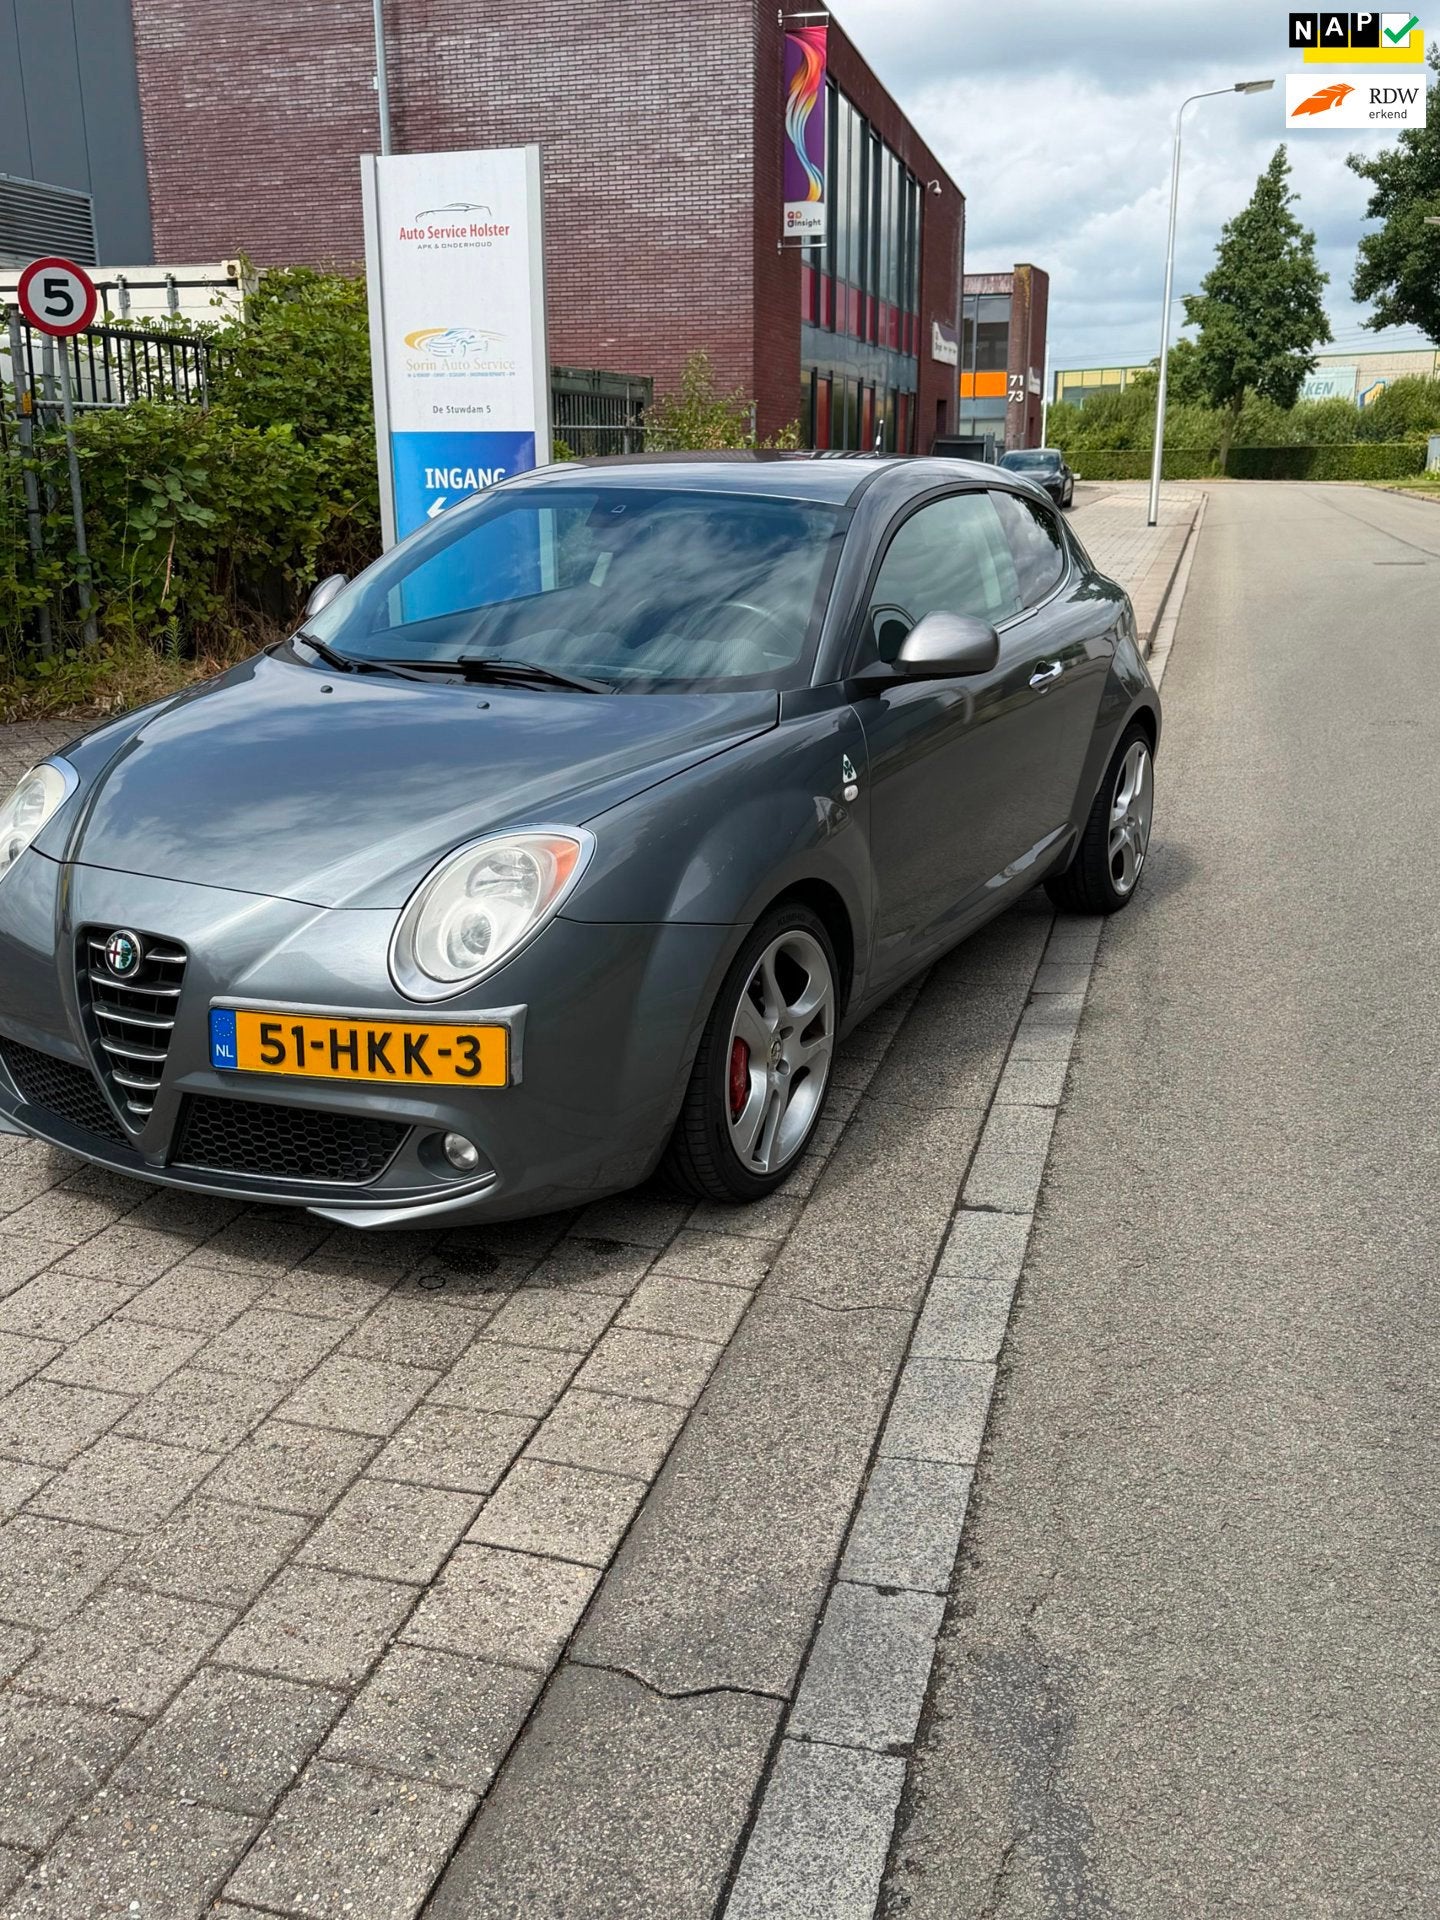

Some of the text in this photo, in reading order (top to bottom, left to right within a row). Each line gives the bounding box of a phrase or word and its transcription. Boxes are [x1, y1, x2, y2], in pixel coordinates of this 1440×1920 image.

[399, 223, 510, 240] Auto Service Holster
[441, 241, 493, 249] ONDERHOUD
[44, 278, 74, 317] 5
[406, 357, 516, 371] Sorin Auto Service
[1009, 375, 1024, 386] 71
[1008, 390, 1024, 402] 73
[432, 404, 492, 414] De Stuwdam 5
[215, 1022, 483, 1078] NL 51-HKK-3
